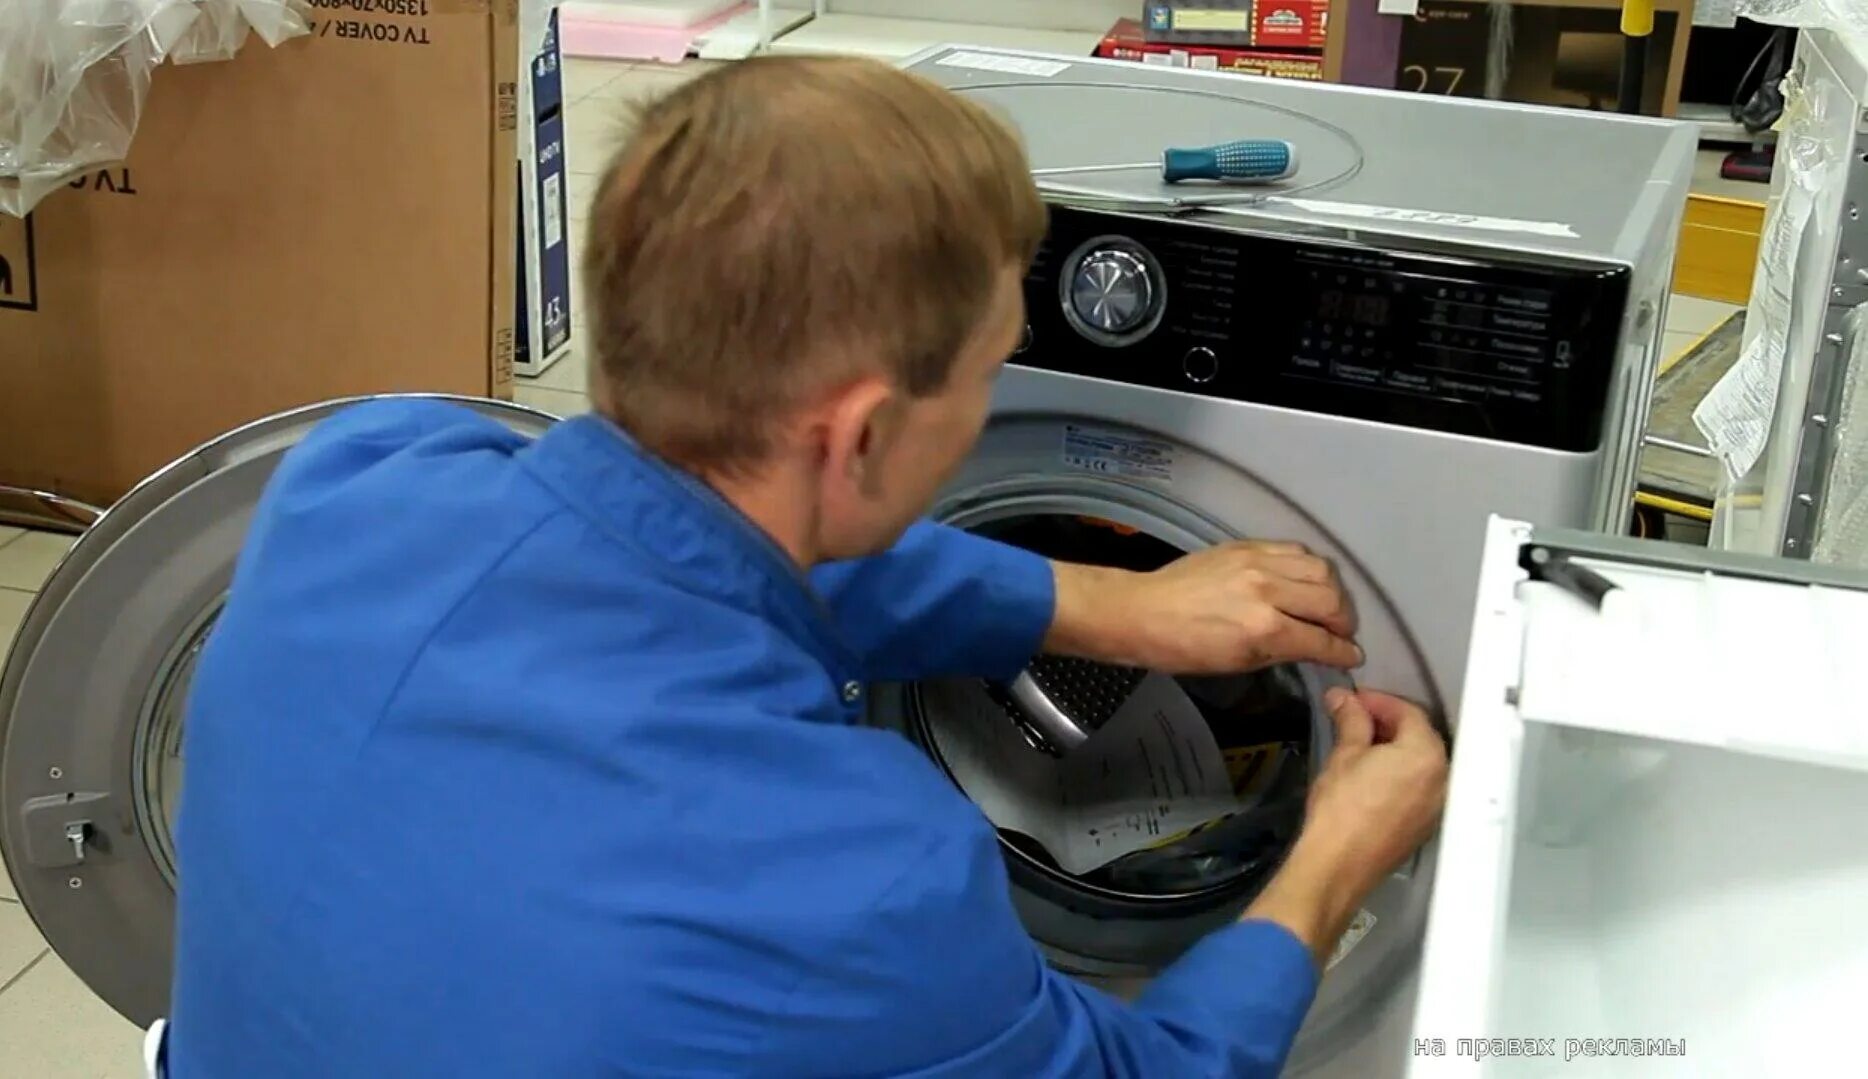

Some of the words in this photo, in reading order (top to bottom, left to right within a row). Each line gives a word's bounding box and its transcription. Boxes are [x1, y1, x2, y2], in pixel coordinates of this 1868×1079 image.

[335, 20, 399, 41] COVER
[404, 27, 430, 44] TV
[1404, 65, 1465, 95] 27
[95, 168, 137, 194] TV
